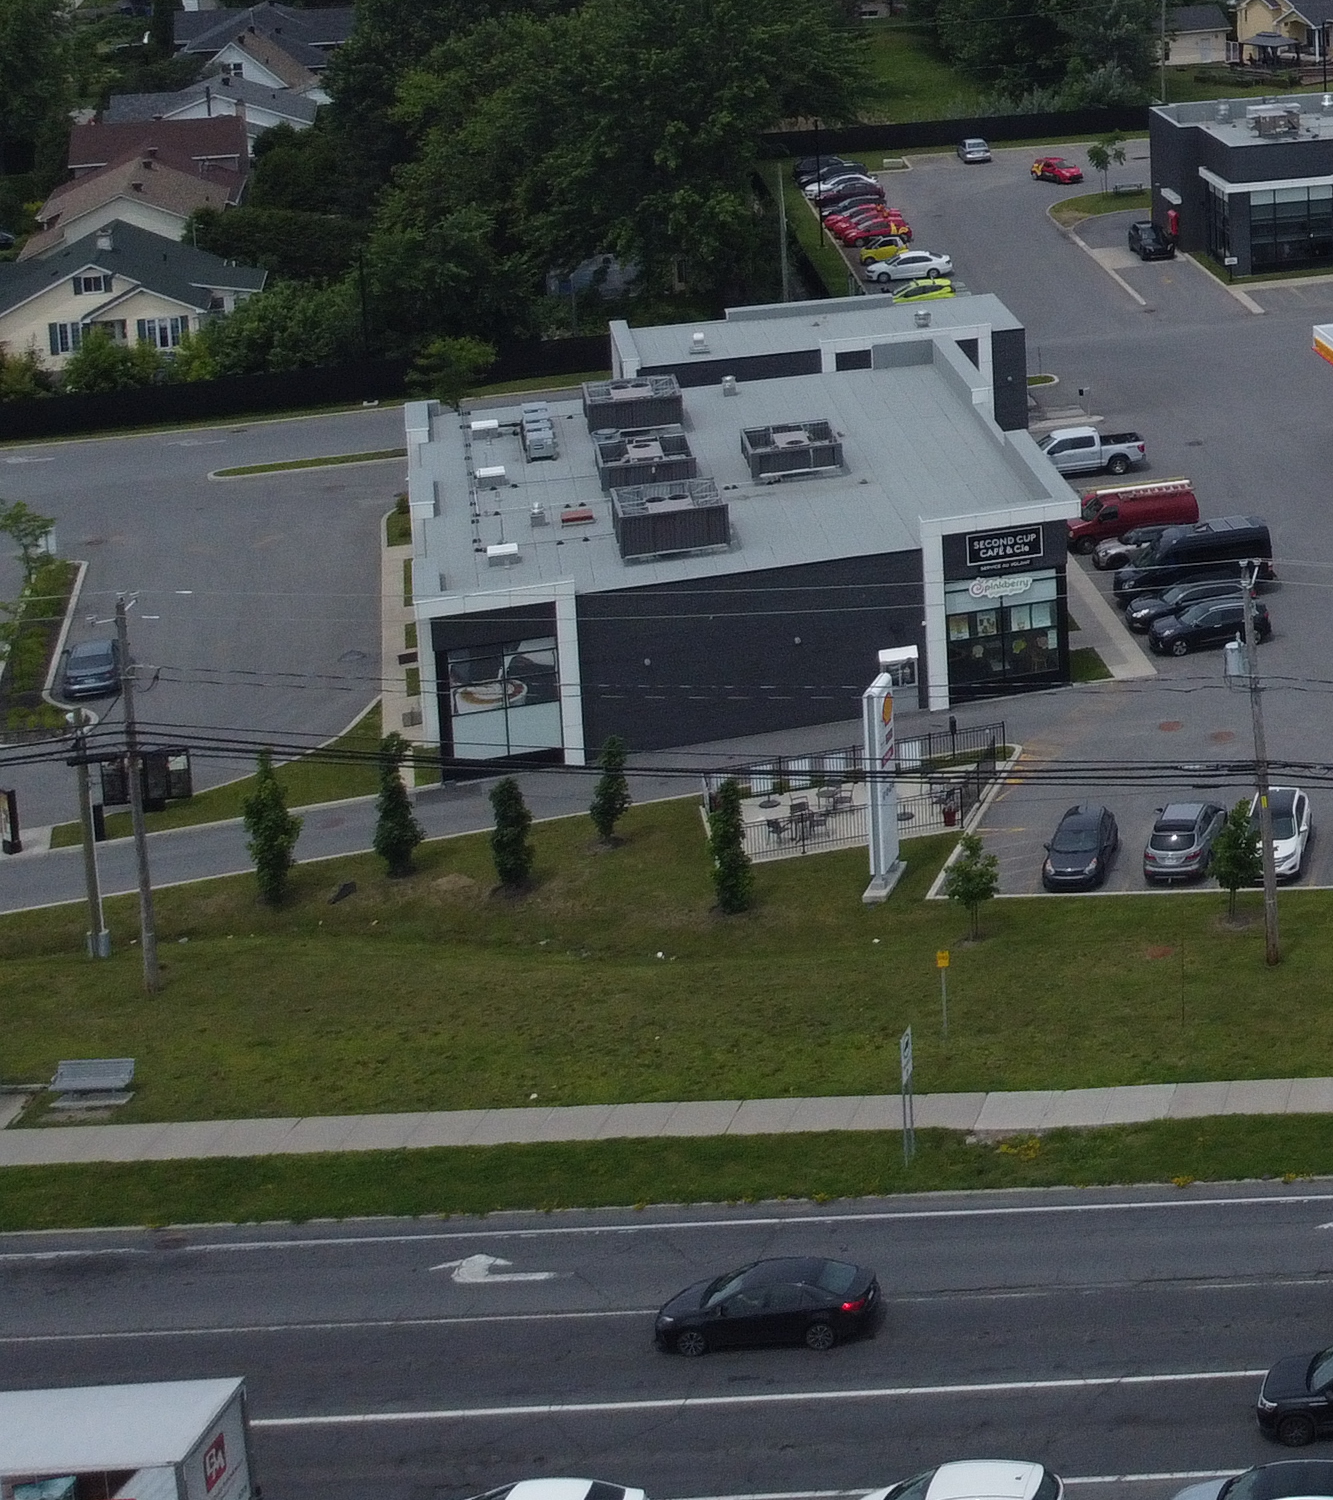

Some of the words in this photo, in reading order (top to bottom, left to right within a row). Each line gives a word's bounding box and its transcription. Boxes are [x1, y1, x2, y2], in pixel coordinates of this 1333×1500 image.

[973, 536, 1014, 549] SECOND
[1016, 533, 1036, 543] CUP
[980, 545, 1005, 558] CAFÉ
[1005, 546, 1013, 554] &
[984, 579, 1029, 593] pinkberry
